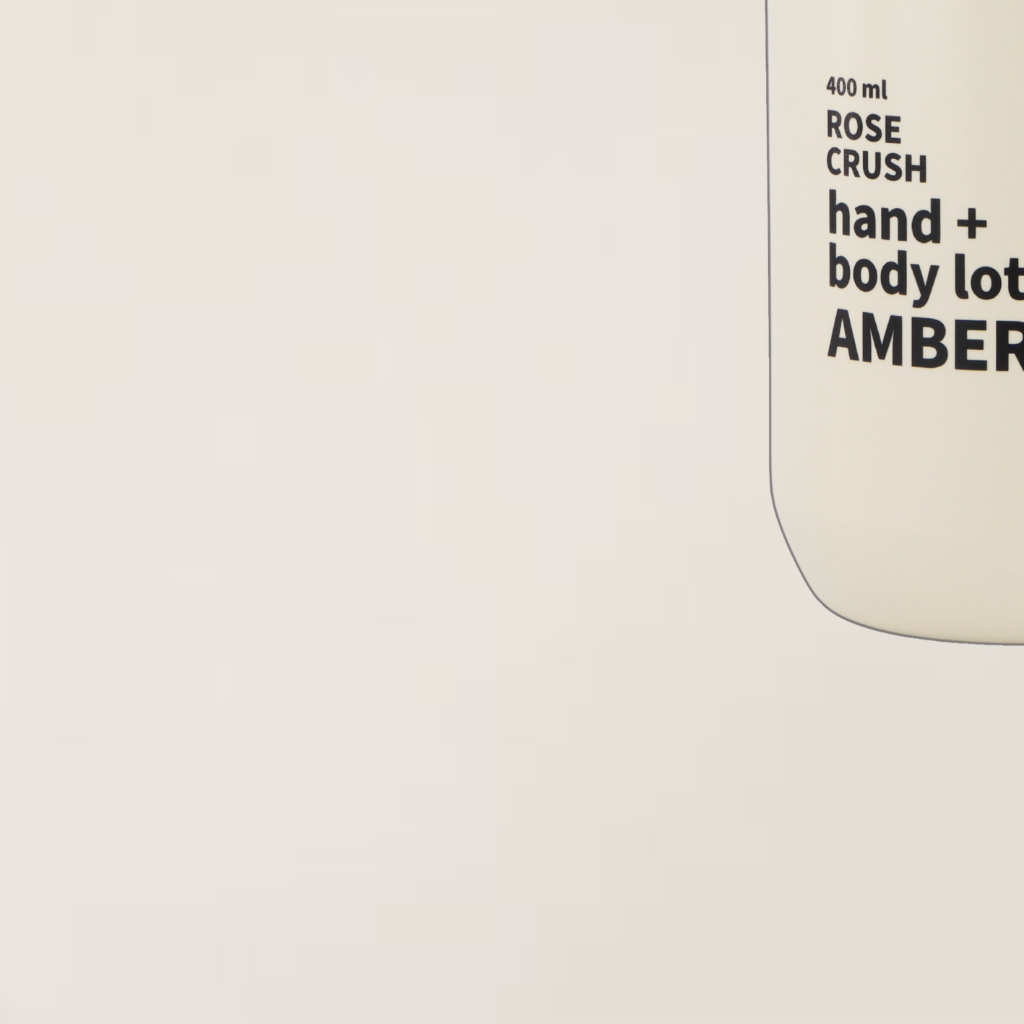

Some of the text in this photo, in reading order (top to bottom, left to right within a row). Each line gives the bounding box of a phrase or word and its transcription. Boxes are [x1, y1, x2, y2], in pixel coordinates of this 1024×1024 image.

[826, 76, 888, 100] 400 ml
[827, 109, 902, 145] ROSE
[826, 146, 927, 184] CRUSH
[828, 188, 988, 244] hand +
[828, 241, 940, 309] body
